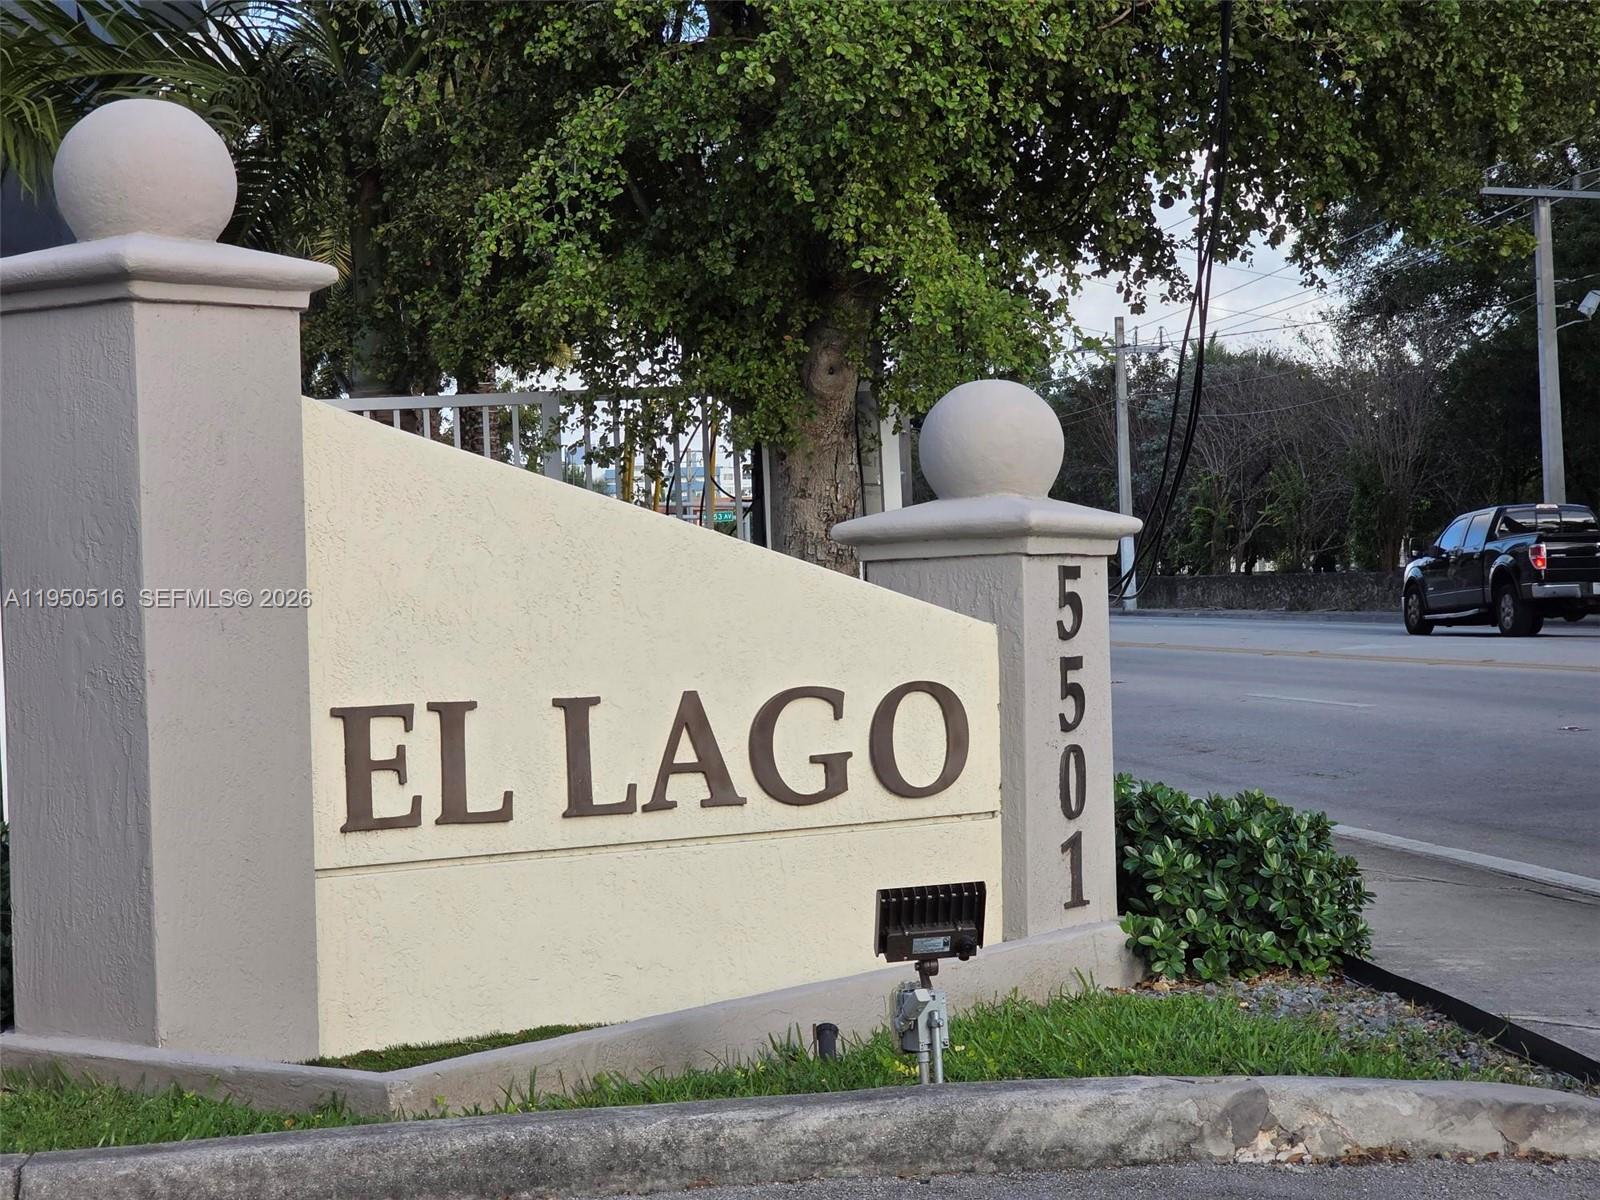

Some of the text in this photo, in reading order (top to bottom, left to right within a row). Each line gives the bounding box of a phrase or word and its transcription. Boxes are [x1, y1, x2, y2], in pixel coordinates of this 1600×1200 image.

[330, 680, 970, 834] EL LAGO
[1056, 564, 1090, 910] 5501
